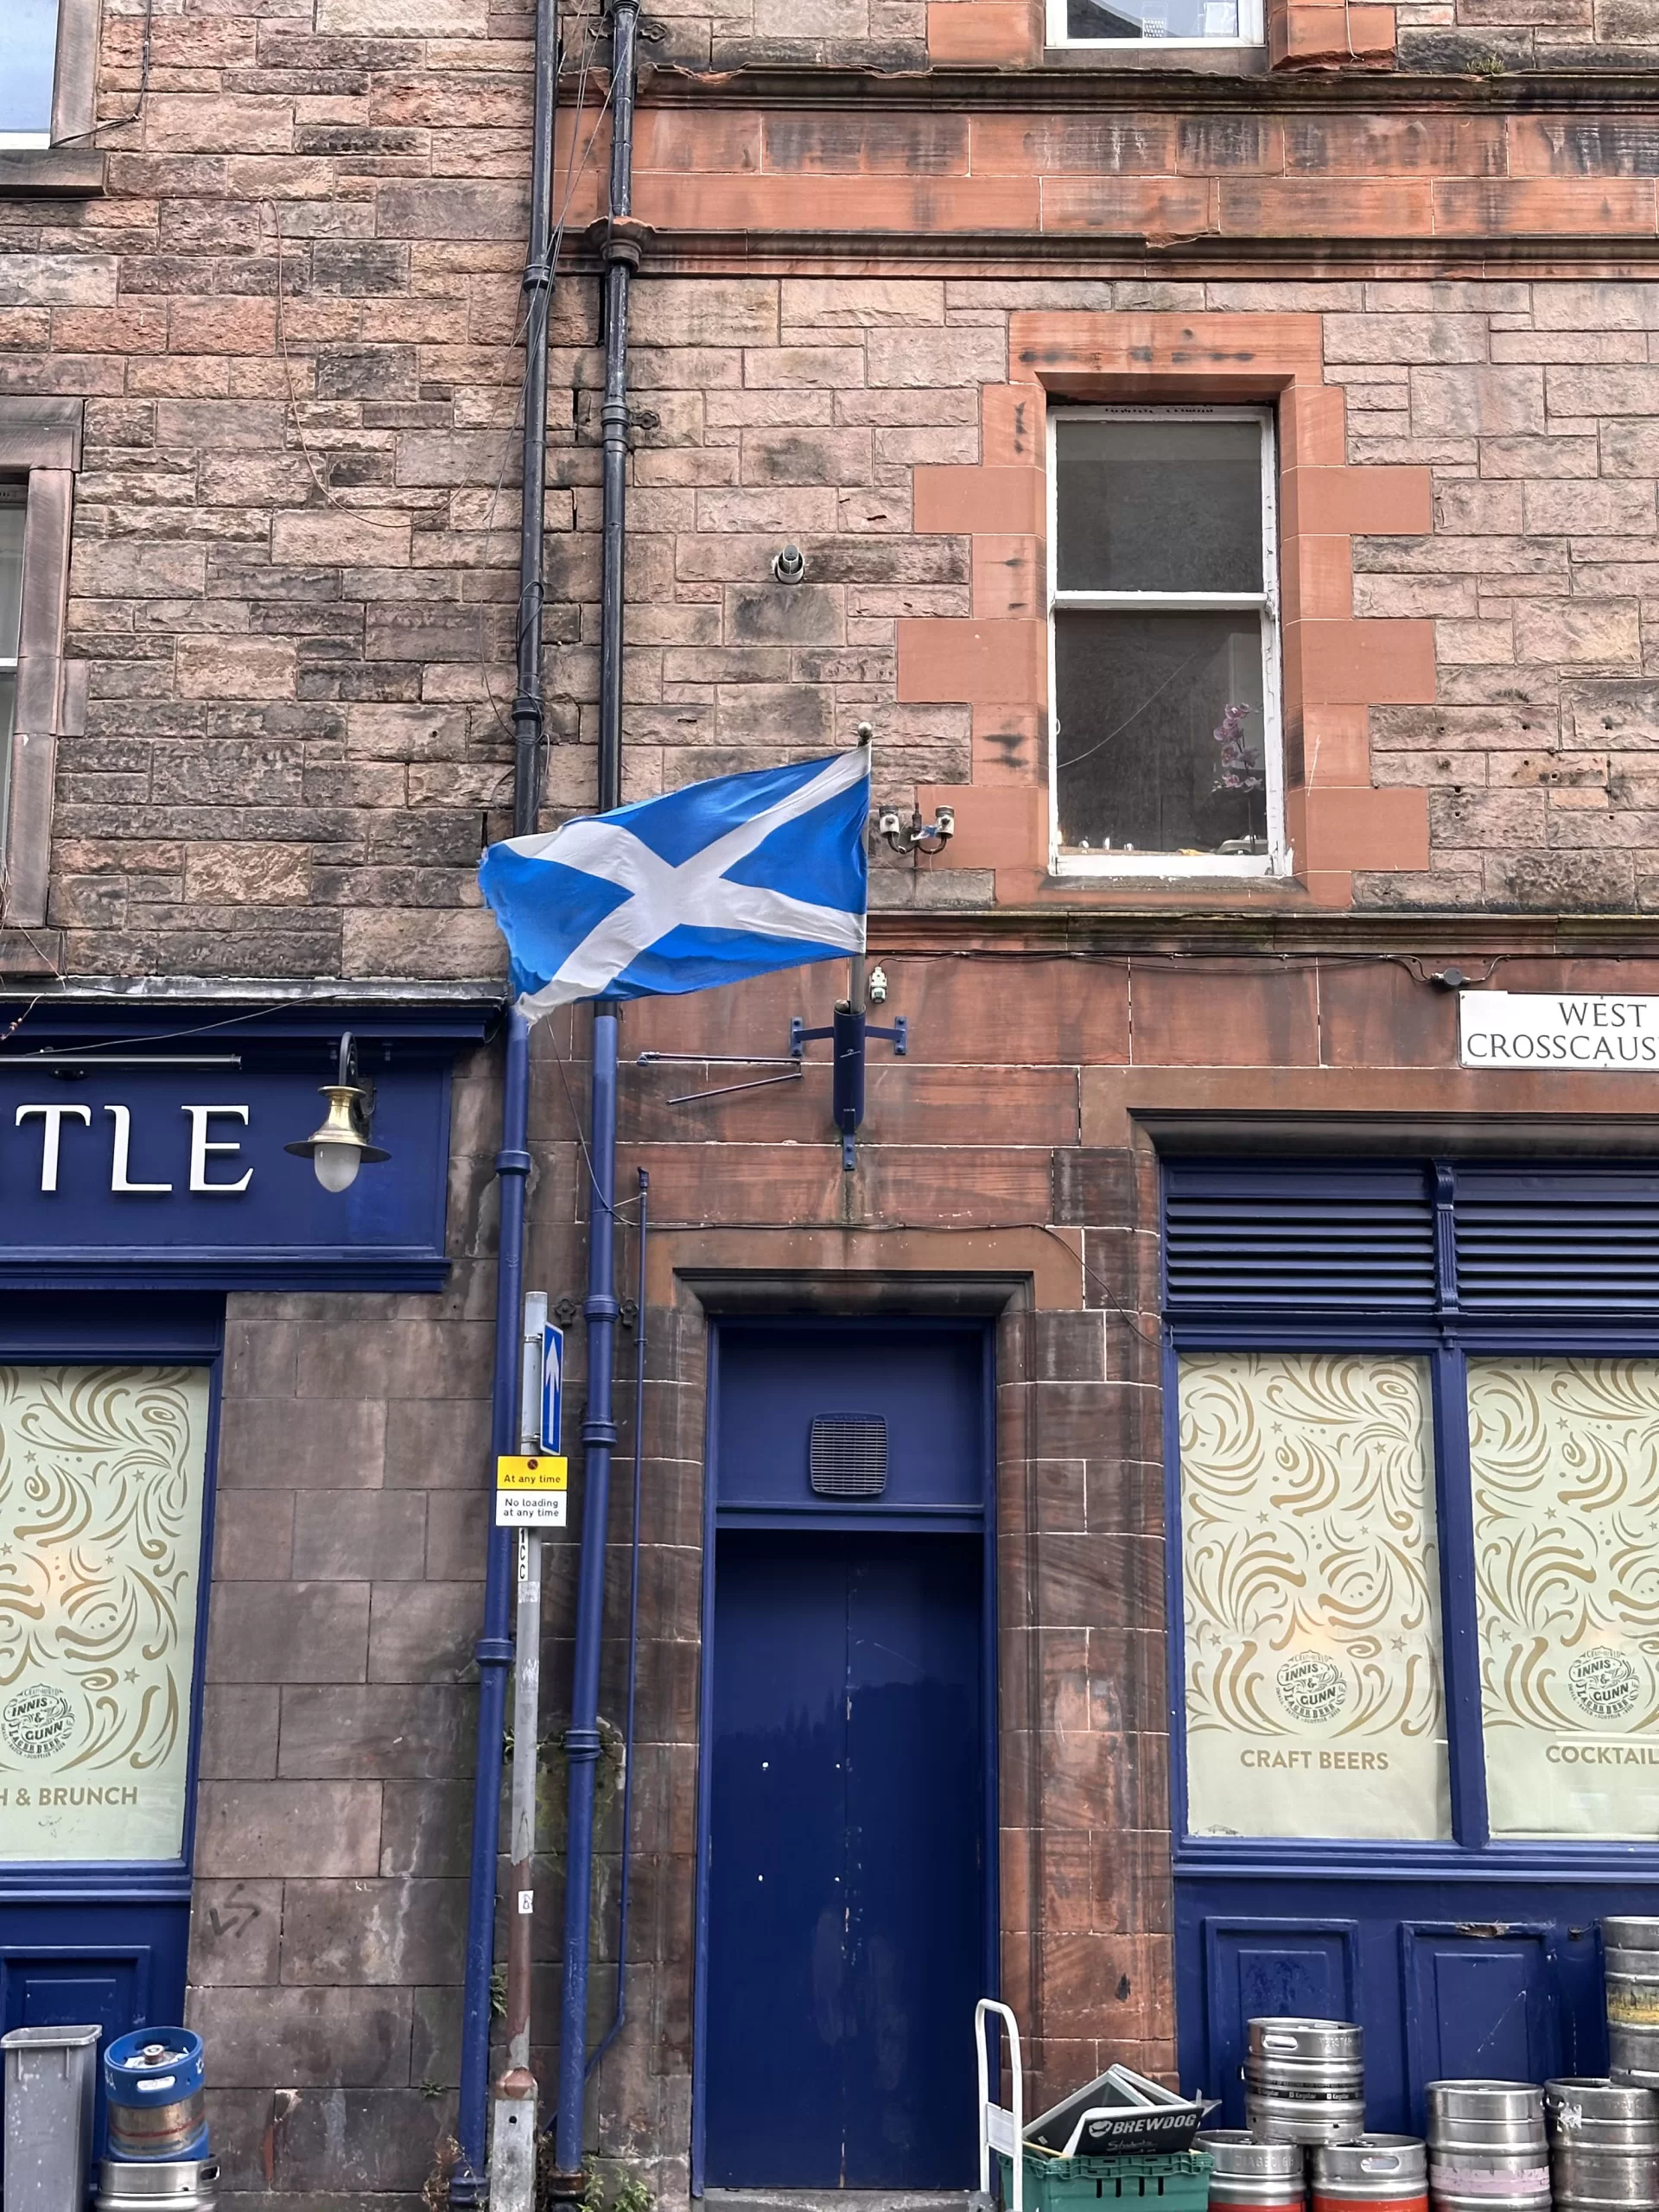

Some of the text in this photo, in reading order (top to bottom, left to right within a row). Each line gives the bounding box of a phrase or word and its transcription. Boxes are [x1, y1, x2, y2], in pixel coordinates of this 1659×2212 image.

[1558, 1002, 1647, 1027] WEST
[1467, 1033, 1659, 1060] CROSSCAUS
[15, 1104, 254, 1192] TLE
[504, 1474, 561, 1484] At any time
[505, 1497, 558, 1509] No loading
[503, 1508, 559, 1518] at any time
[1285, 1663, 1319, 1681] INNIS
[1577, 1659, 1611, 1677] INNIS
[1307, 1677, 1317, 1688] &
[1600, 1674, 1610, 1684] &
[1300, 1686, 1336, 1705] GUNN
[1593, 1682, 1629, 1701] GUNN
[12, 1697, 48, 1717] INNIS
[35, 1712, 45, 1723] &
[25, 1720, 63, 1740] GUNN
[1240, 1749, 1389, 1770] CRAFT BEERS
[16, 1788, 31, 1806] &
[39, 1786, 138, 1806] BRUNCH
[1111, 2113, 1198, 2135] BREWDOG
